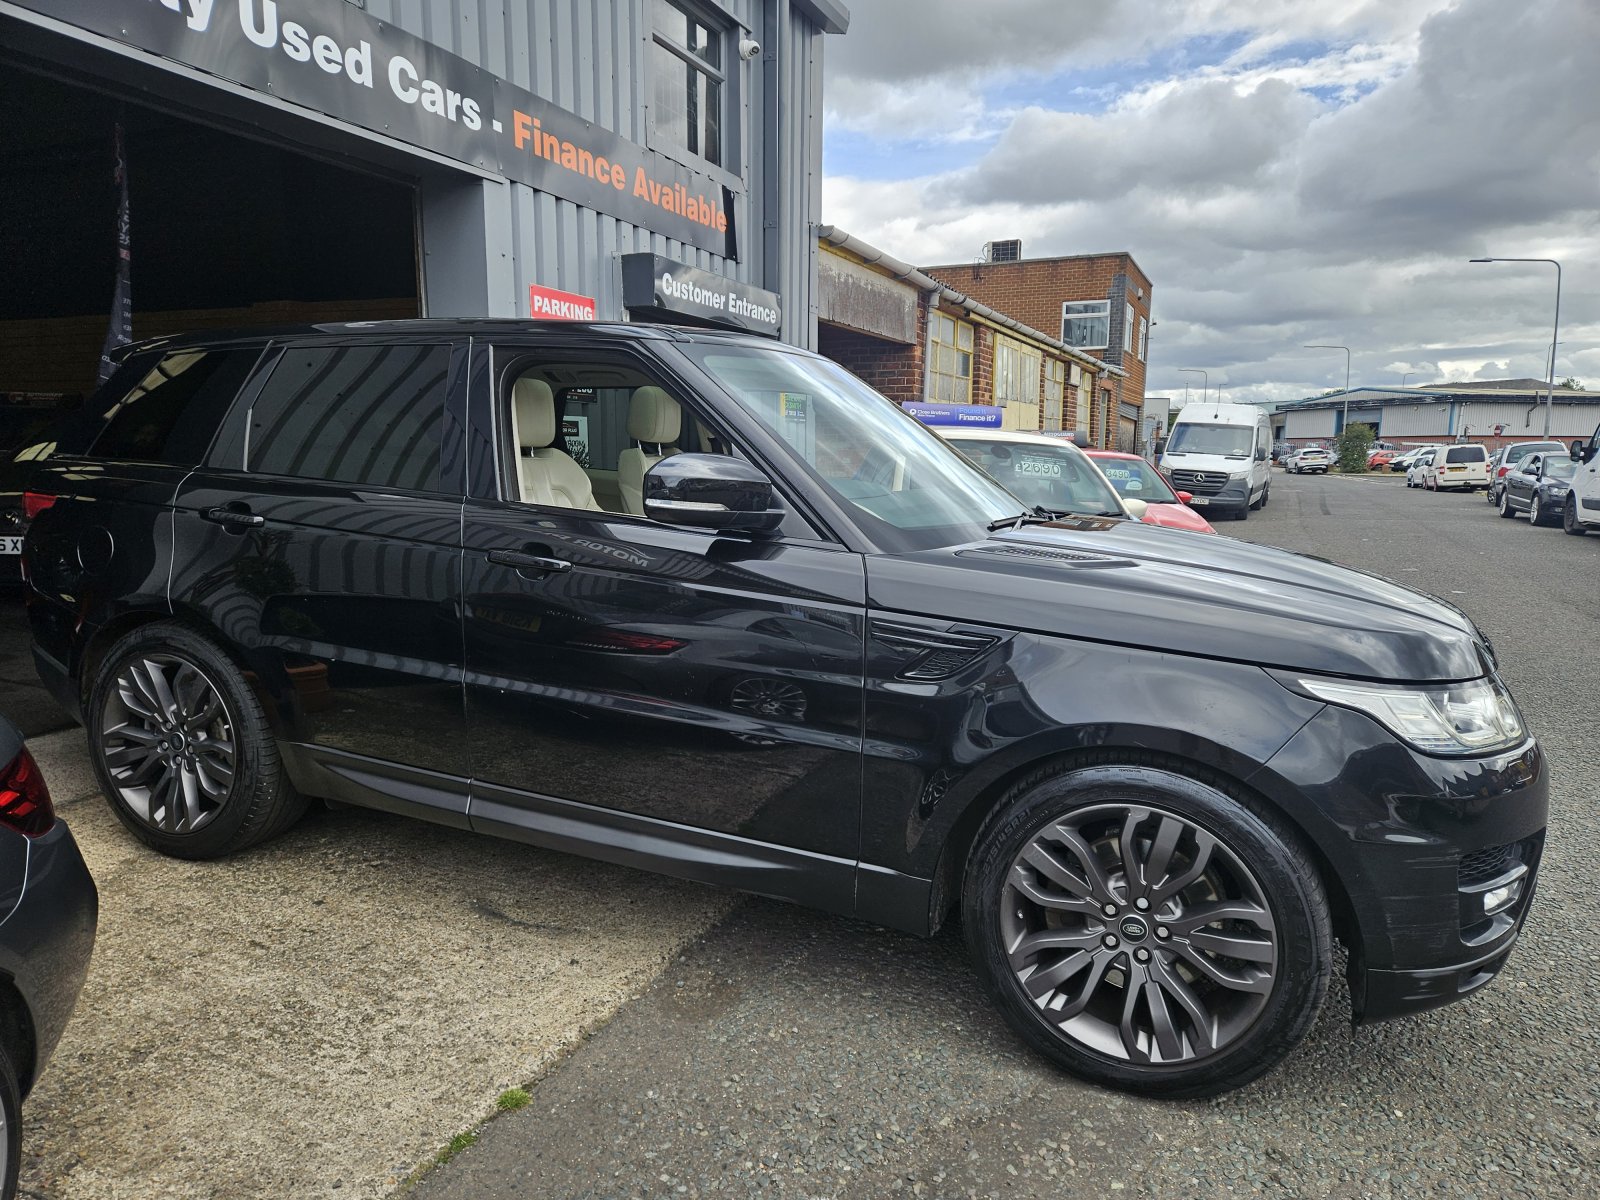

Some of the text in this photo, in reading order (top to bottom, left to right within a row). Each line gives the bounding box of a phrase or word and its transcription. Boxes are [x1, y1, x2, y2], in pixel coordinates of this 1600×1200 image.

[239, 0, 374, 89] Used
[388, 55, 482, 131] Cars
[513, 109, 626, 190] Finance
[633, 166, 728, 233] Available
[533, 295, 594, 321] PARKING
[662, 272, 777, 324] Customer Entrance
[959, 413, 985, 422] Finance
